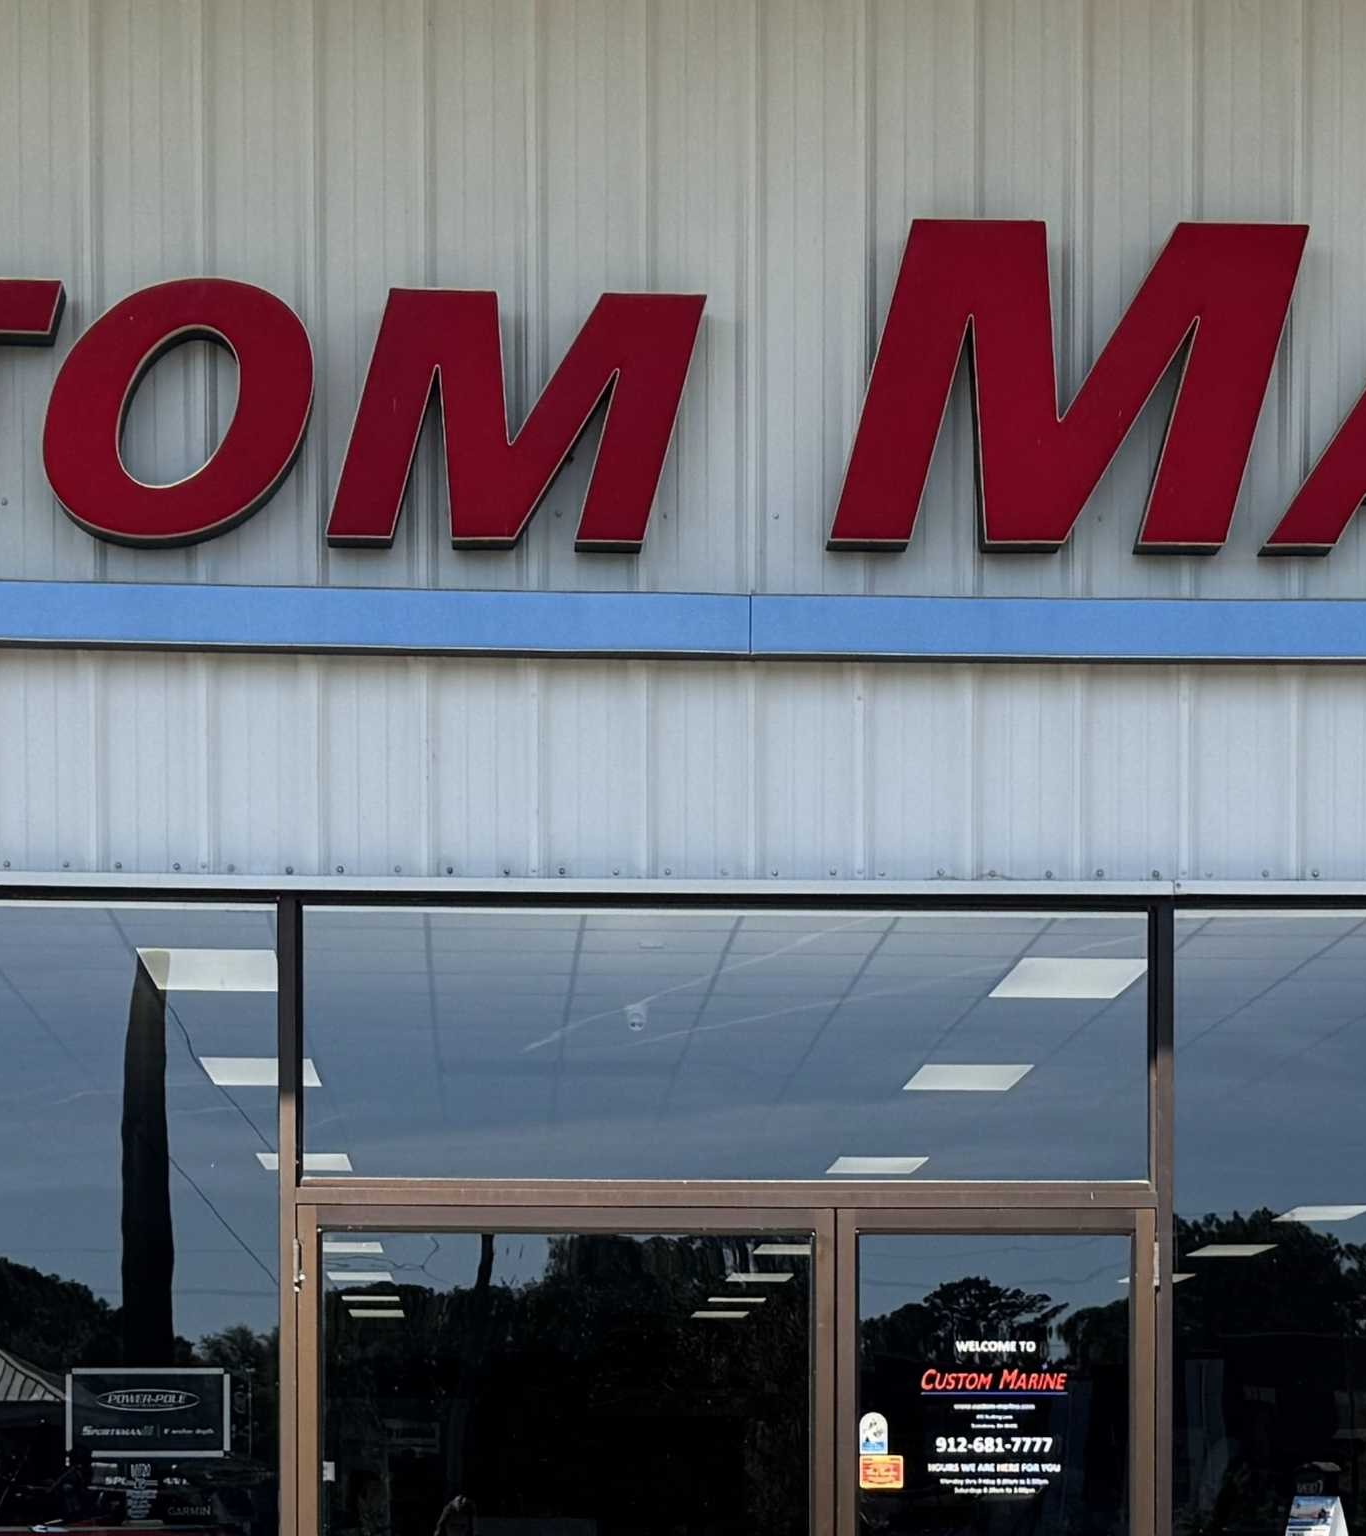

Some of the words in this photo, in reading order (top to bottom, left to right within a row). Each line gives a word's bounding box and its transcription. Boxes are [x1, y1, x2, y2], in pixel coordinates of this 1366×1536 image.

[955, 1340, 1017, 1352] WELCOME
[1018, 1340, 1037, 1352] TO
[920, 1368, 993, 1391] CUSTOM
[998, 1368, 1068, 1391] MARINE
[107, 1393, 187, 1405] POWER-POLE
[934, 1436, 1054, 1453] 912-681-7777
[1021, 1463, 1040, 1473] FOR
[1040, 1463, 1062, 1473] YOU
